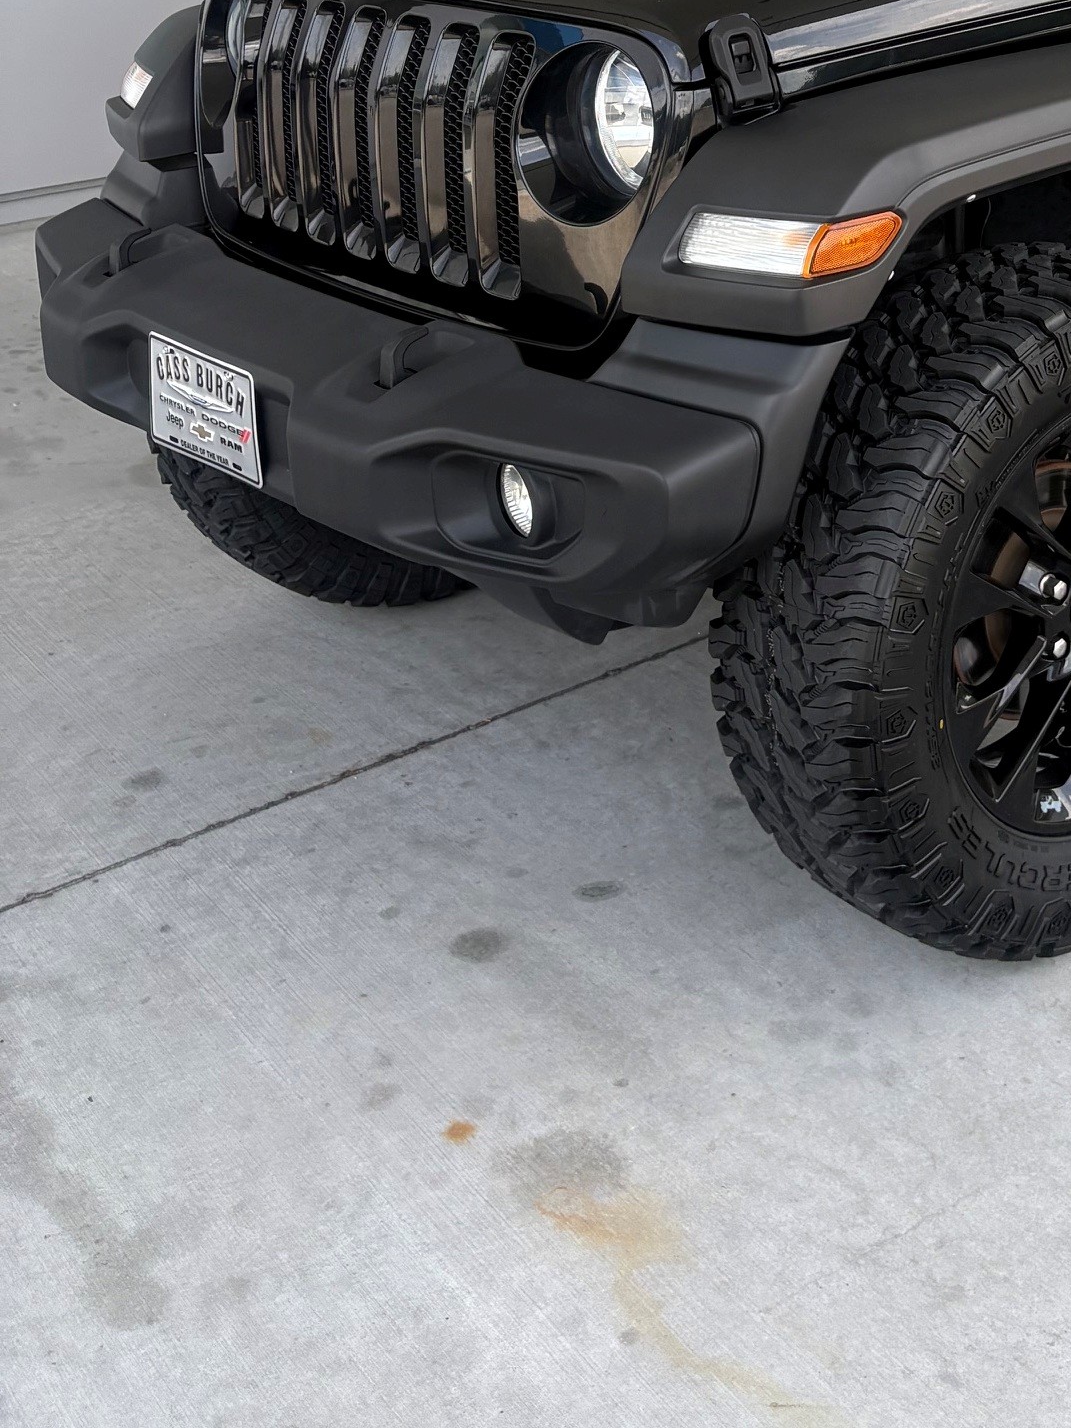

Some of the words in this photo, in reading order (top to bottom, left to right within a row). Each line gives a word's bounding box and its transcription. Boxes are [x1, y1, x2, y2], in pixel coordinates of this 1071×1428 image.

[156, 355, 190, 382] CASS
[196, 364, 244, 418] BURCH
[159, 394, 195, 416] CHRYSLER
[202, 413, 243, 436] DODGE
[166, 410, 184, 430] Jeep
[181, 440, 199, 452] DEALER
[199, 446, 206, 455] OF
[206, 450, 216, 461] THE
[216, 453, 230, 466] YEAR
[220, 437, 243, 453] RAM
